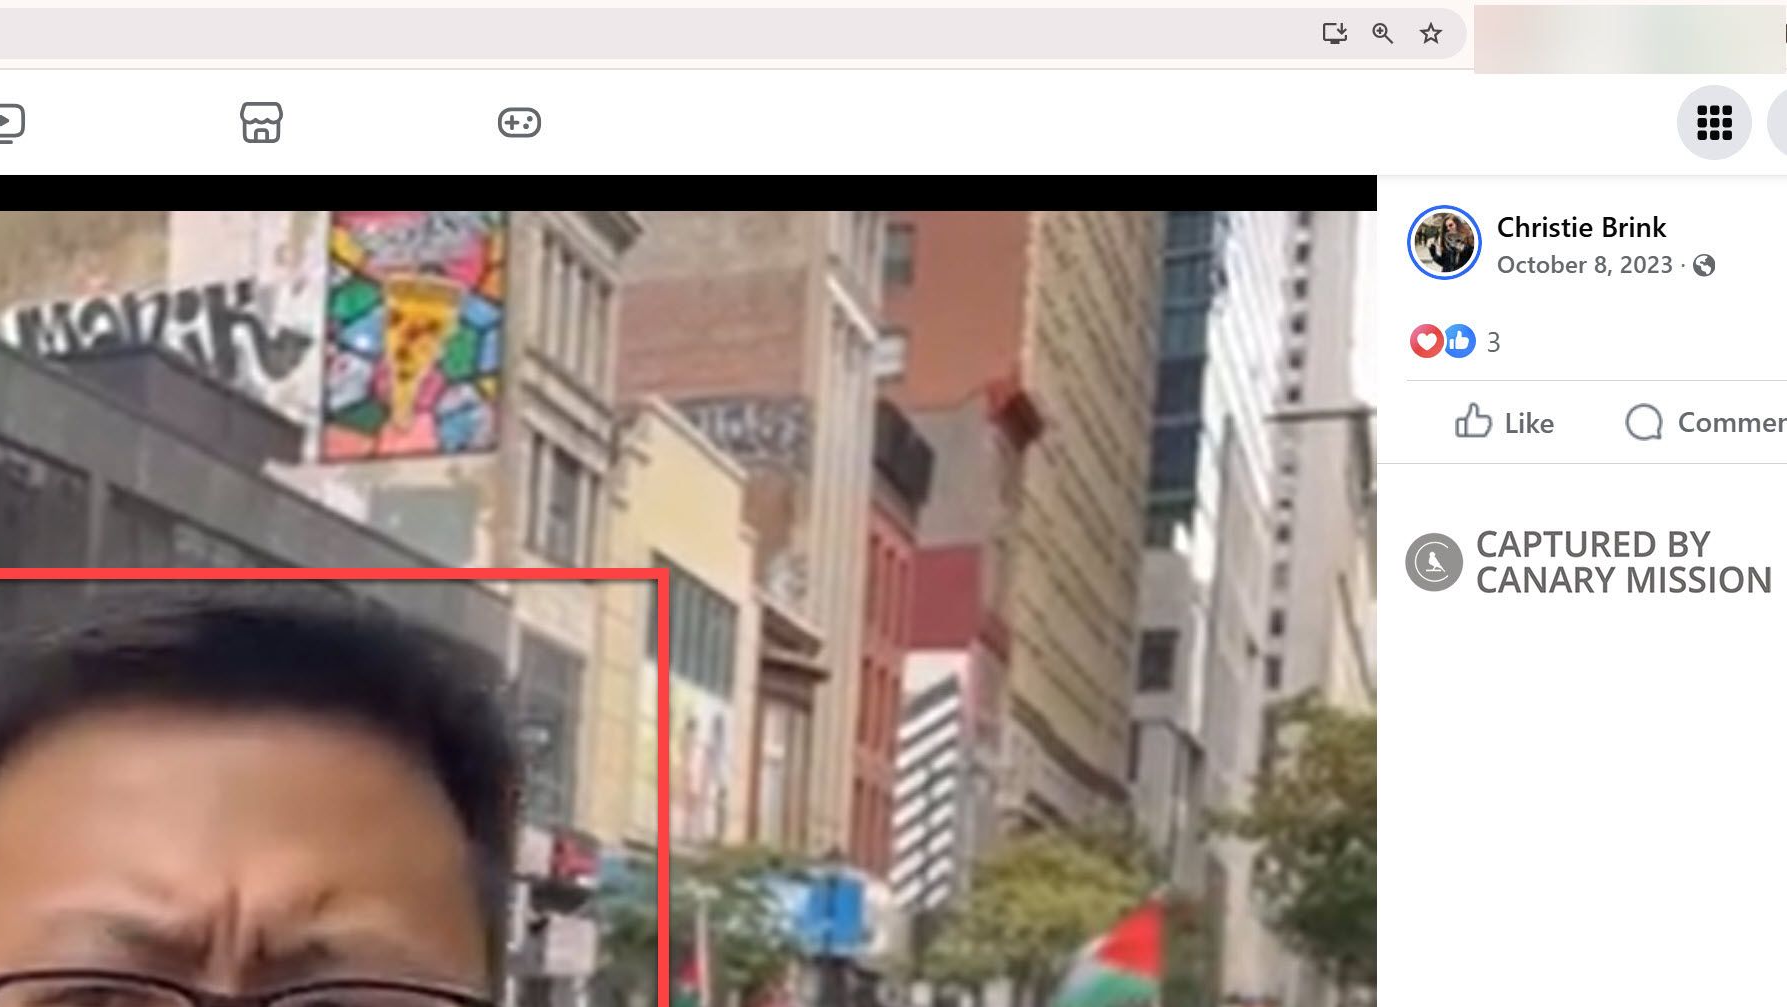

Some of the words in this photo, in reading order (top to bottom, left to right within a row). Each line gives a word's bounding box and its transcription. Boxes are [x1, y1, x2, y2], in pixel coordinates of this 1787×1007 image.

[1497, 215, 1594, 238] Christie
[1602, 215, 1668, 238] Brink
[1497, 254, 1588, 274] October
[1594, 255, 1613, 278] 8,
[1620, 255, 1673, 274] 2023
[1487, 331, 1501, 353] 3
[1505, 411, 1555, 434] Like
